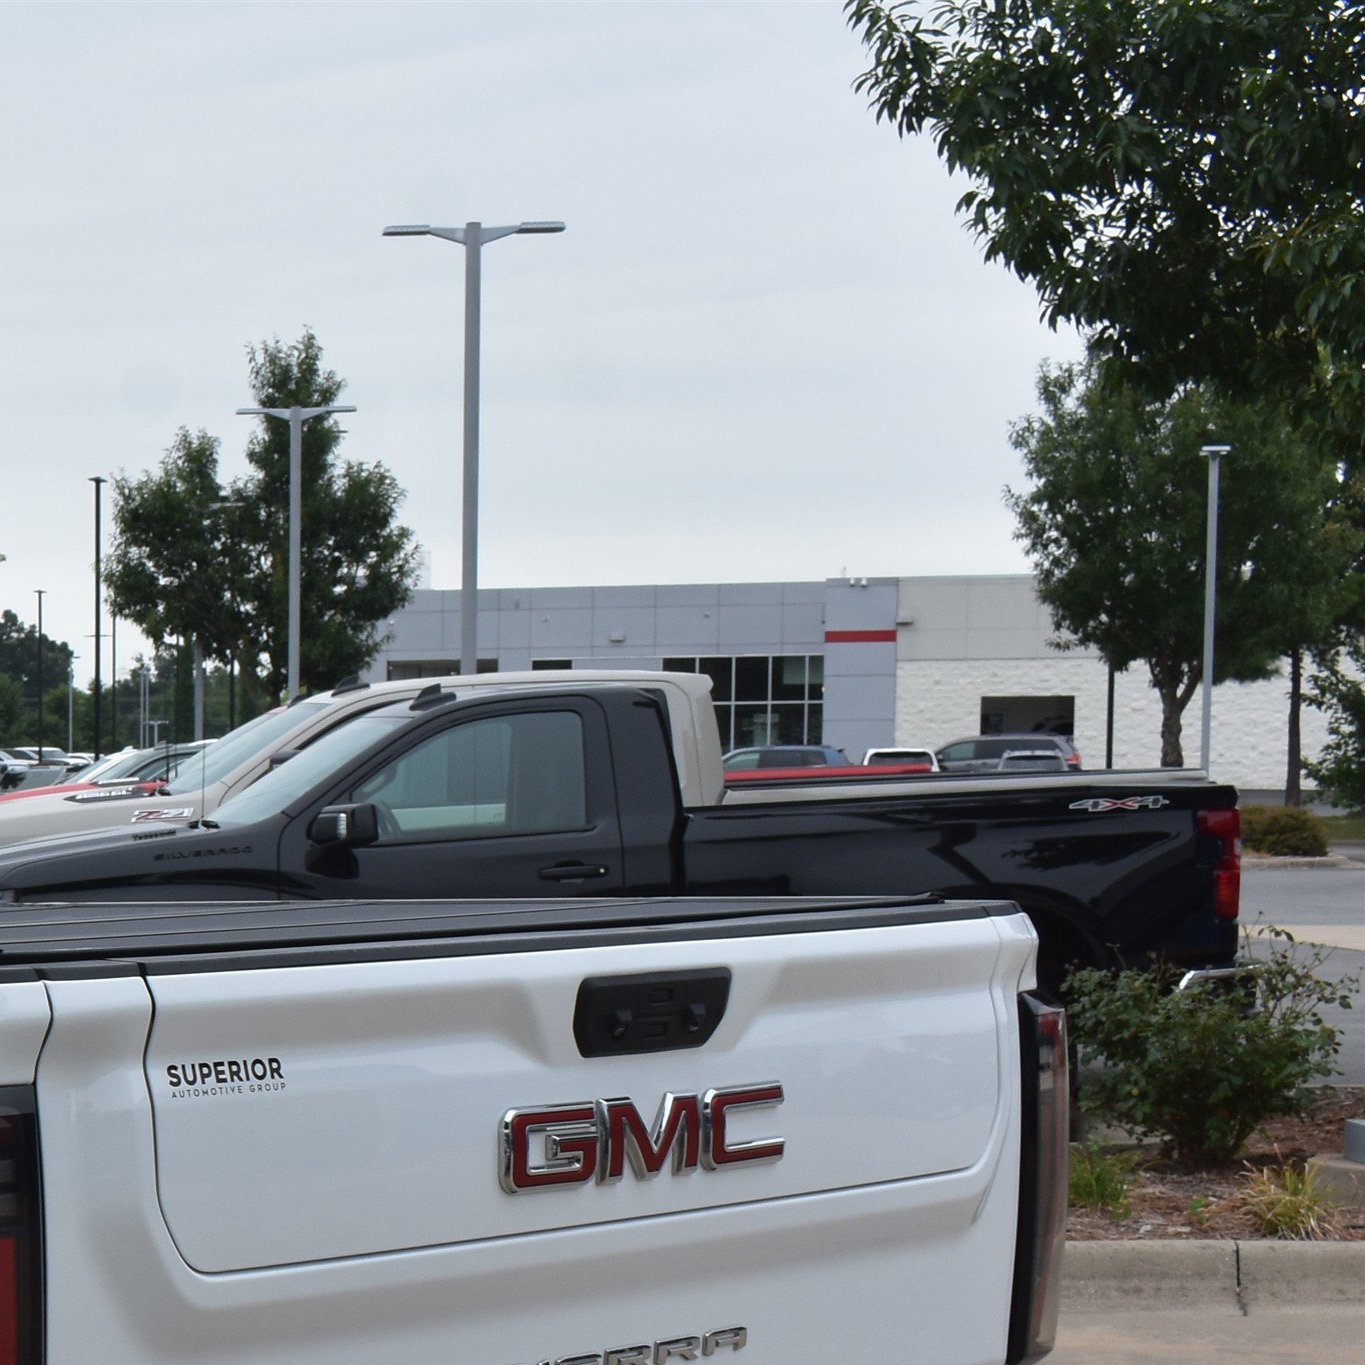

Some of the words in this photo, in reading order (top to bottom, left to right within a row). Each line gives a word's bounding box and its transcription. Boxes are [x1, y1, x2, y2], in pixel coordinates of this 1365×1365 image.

[166, 1057, 285, 1088] SUPERIOR
[171, 1085, 244, 1099] AUTOMOTIVE
[249, 1082, 287, 1093] GROUP
[498, 1080, 786, 1195] GMC
